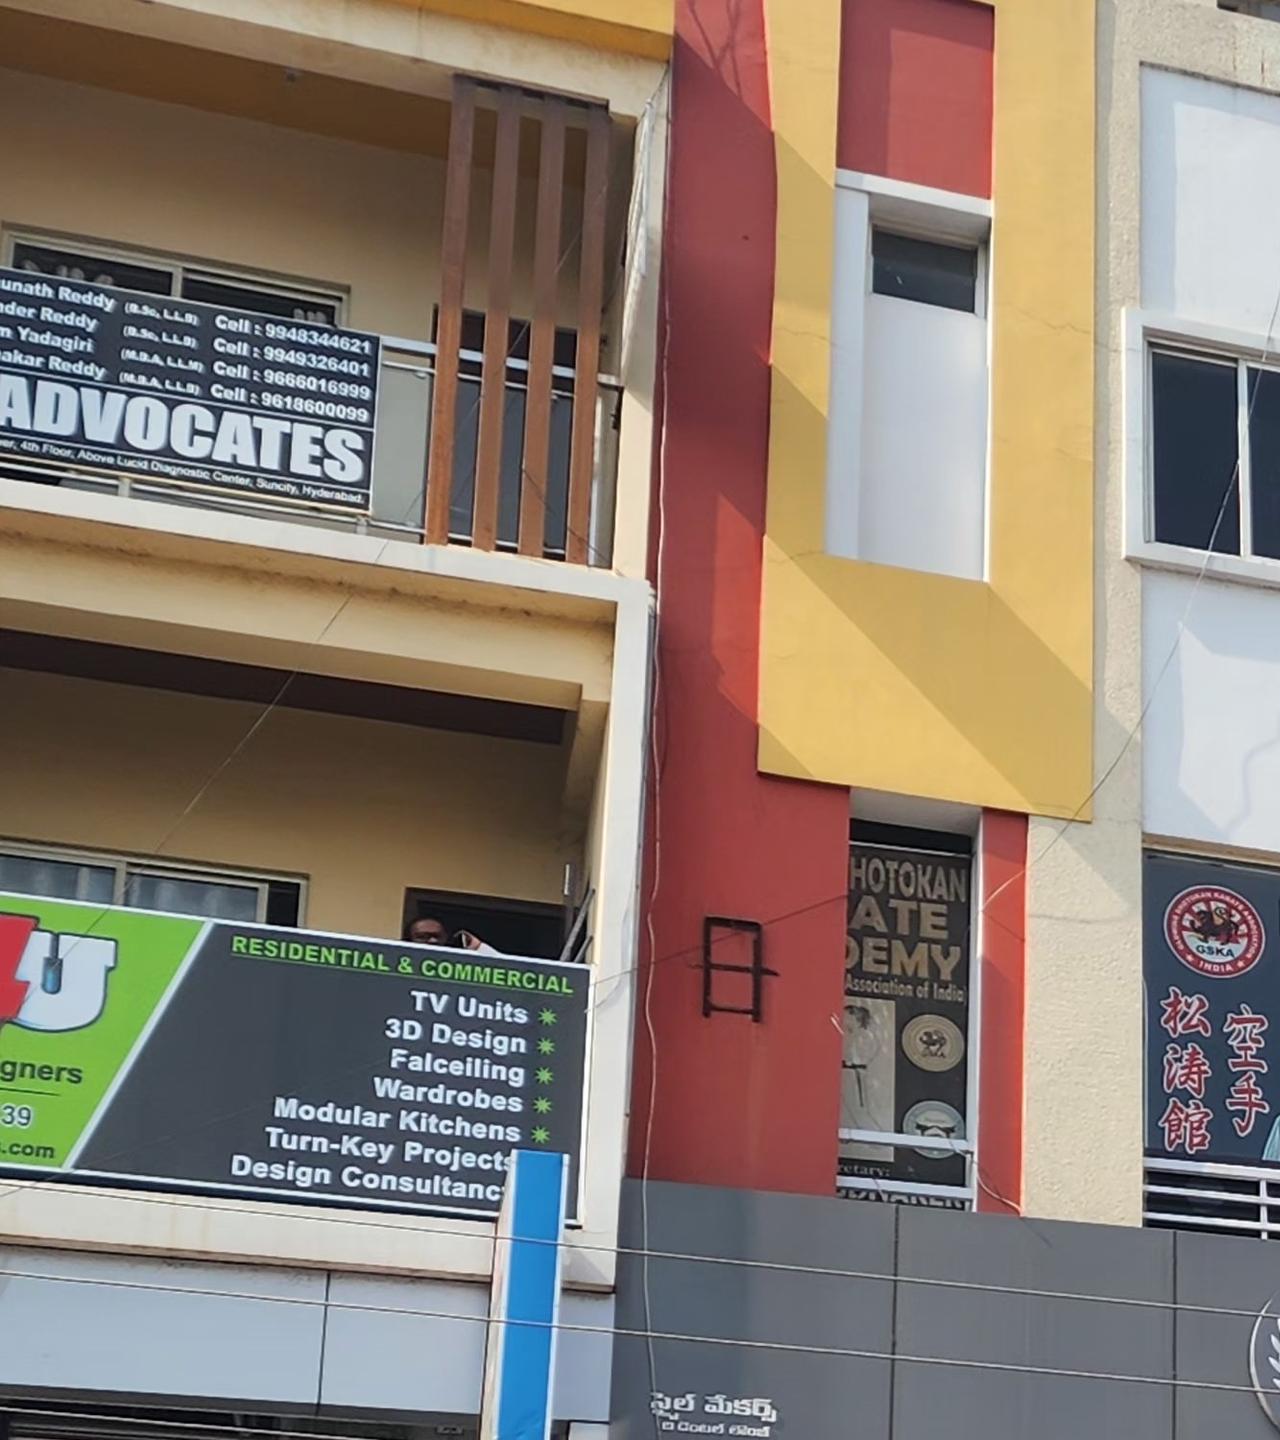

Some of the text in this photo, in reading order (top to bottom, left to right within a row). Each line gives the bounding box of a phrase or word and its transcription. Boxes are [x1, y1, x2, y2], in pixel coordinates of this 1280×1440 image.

[58, 286, 115, 312] Reddy
[40, 306, 98, 332] Reddy
[215, 315, 371, 355] Cell 9948344621
[18, 326, 95, 352] Yadagiri
[214, 338, 370, 376] Cell 9949326401
[48, 356, 107, 381] Reddy
[214, 361, 371, 400] Cell 9666016999
[210, 384, 369, 423] Cell 9618600099
[0, 373, 364, 483] ADVOCATES
[78, 450, 148, 470] Above Lucid
[231, 935, 574, 994] RESIDENTIAL & COMMERCIAL
[410, 991, 529, 1024] TV Units
[916, 983, 930, 1000] of
[384, 1018, 528, 1055] 3D Design
[390, 1049, 526, 1087] Falceiling
[1223, 1003, 1270, 1137] 空手
[373, 1077, 524, 1113] Wardrobes
[273, 1096, 521, 1143] Modular Kitchens
[264, 1127, 395, 1164] Turn-Key
[231, 1155, 332, 1186] Design
